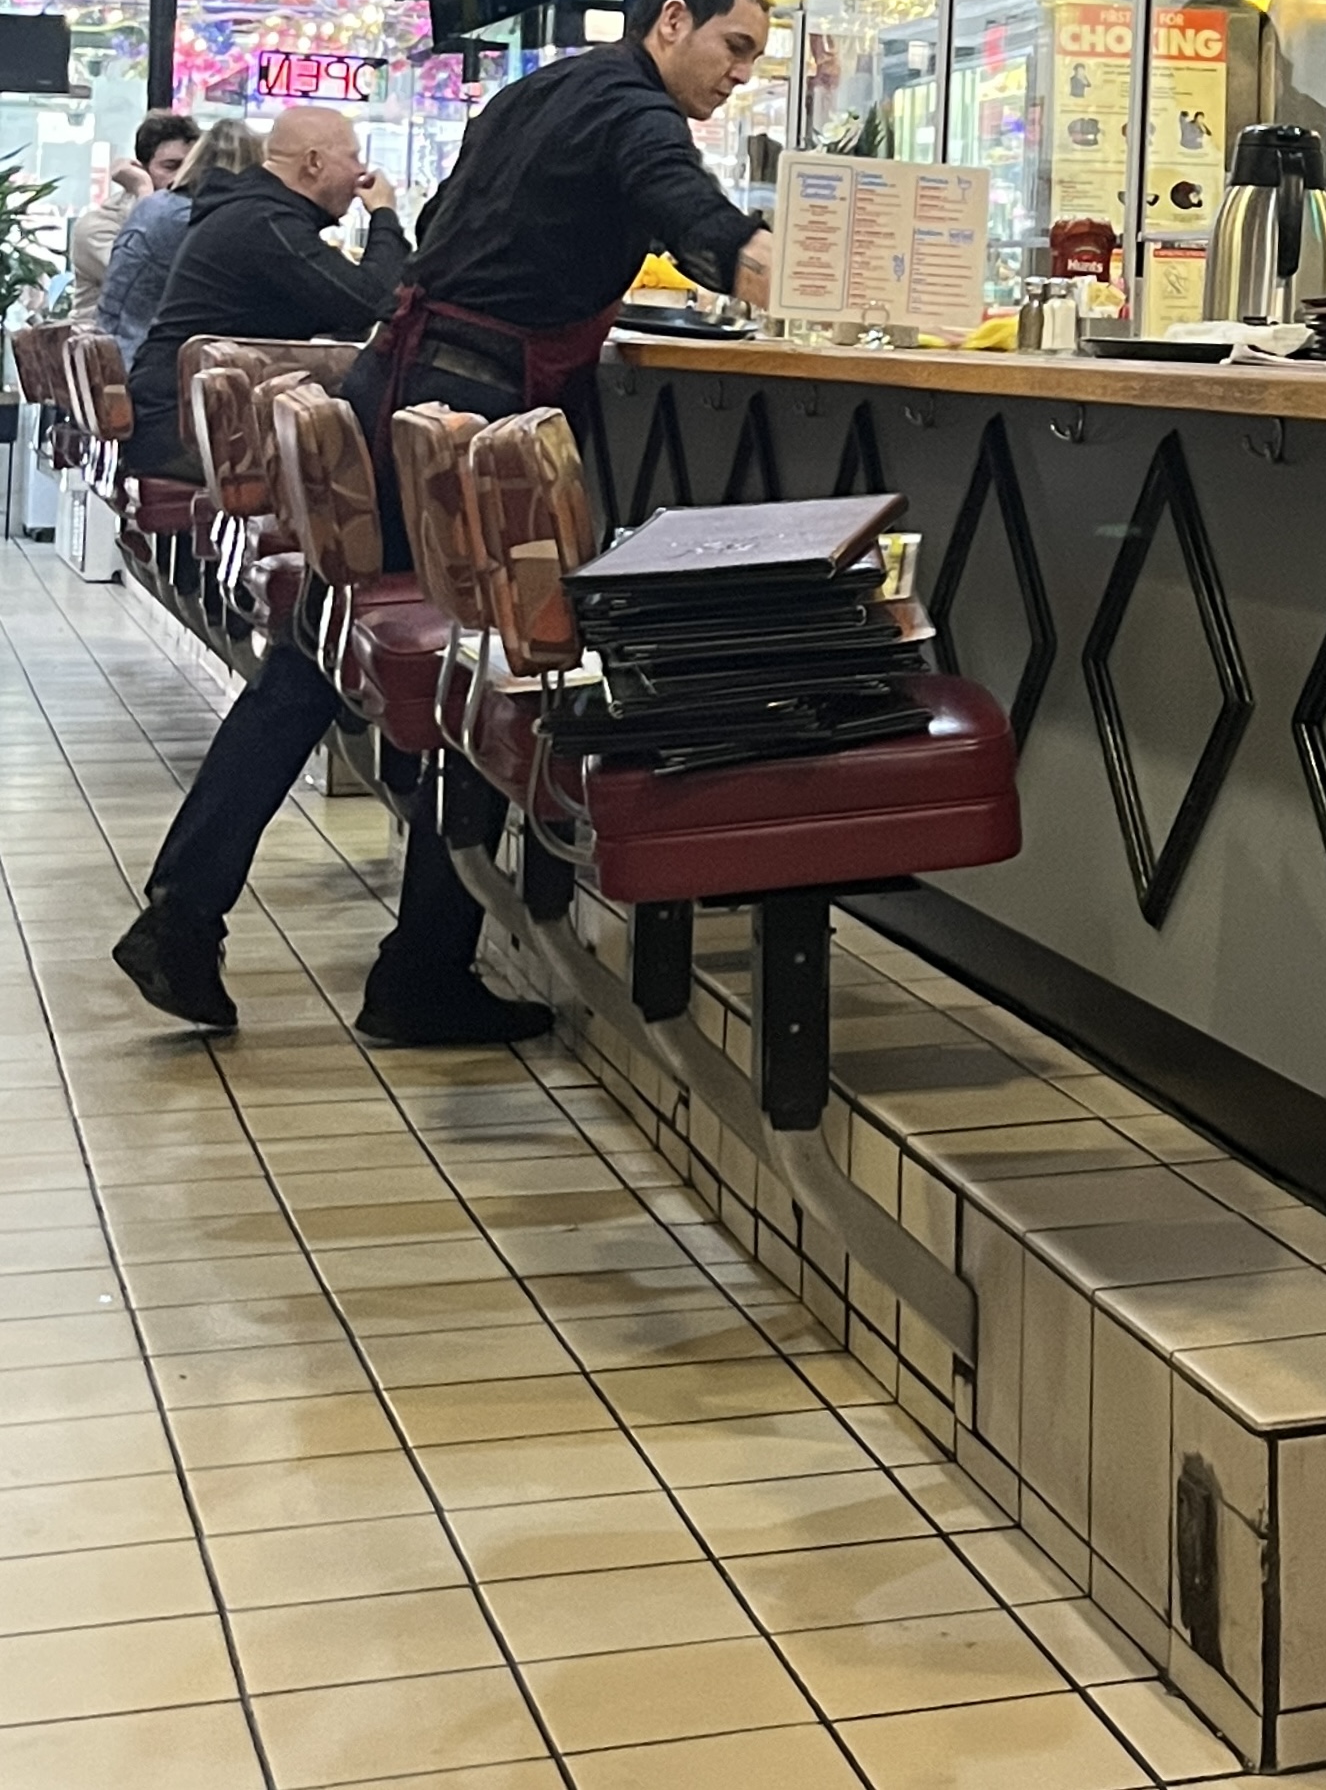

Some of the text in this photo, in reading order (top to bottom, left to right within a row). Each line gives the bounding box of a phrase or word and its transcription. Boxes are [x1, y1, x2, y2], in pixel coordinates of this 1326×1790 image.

[1101, 10, 1185, 26] FIRST FOR
[1059, 25, 1223, 58] CHOING
